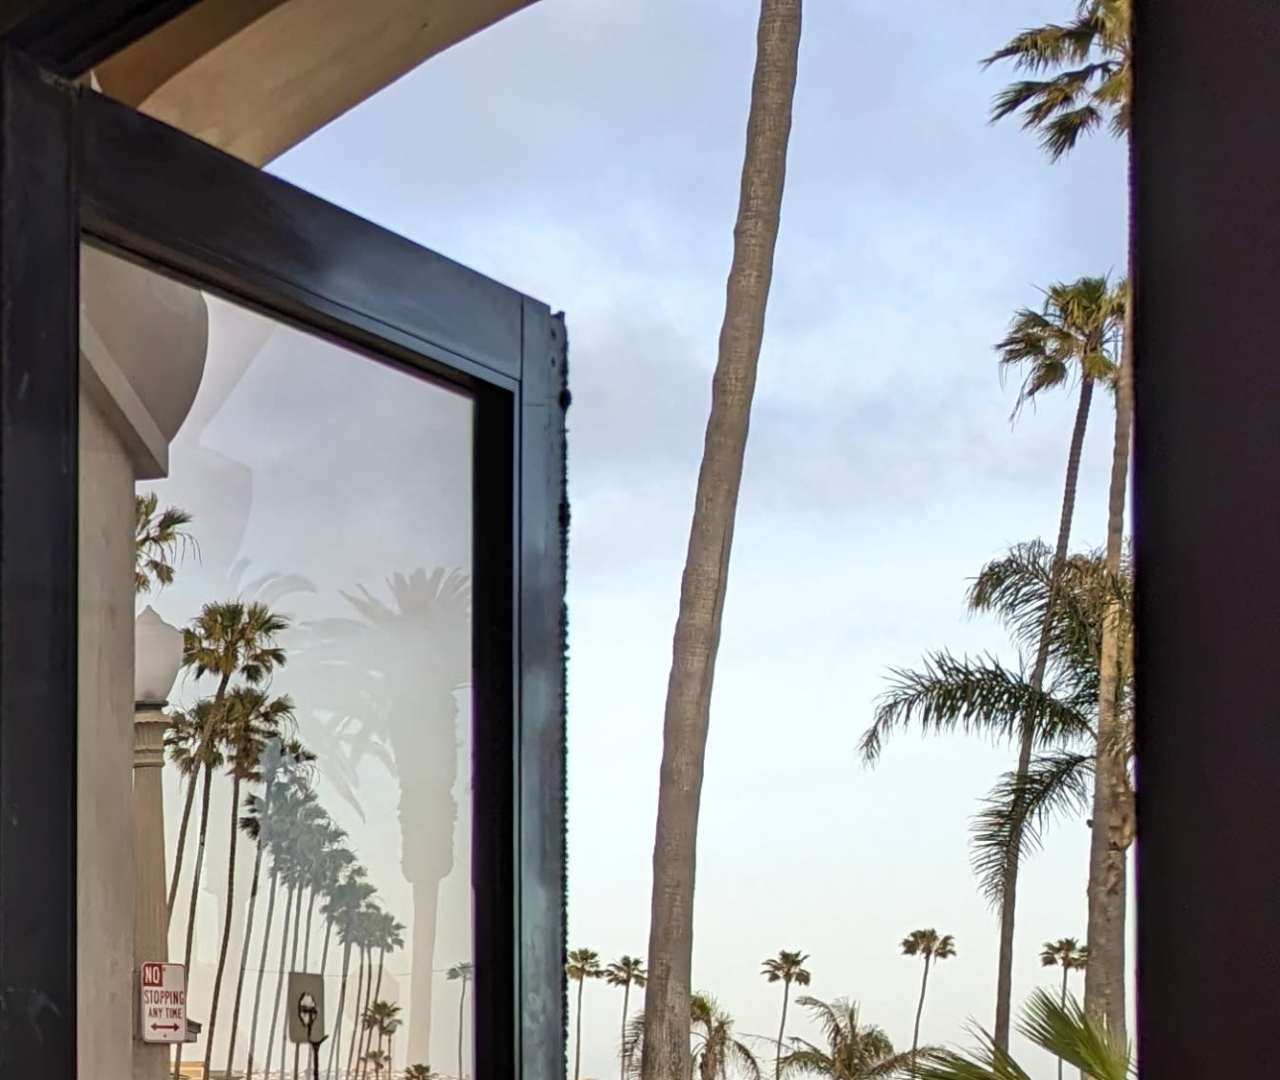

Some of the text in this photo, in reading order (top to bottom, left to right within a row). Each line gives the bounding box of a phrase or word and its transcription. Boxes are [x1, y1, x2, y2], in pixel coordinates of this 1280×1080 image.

[145, 966, 160, 984] NO
[144, 990, 184, 1005] STOPPING
[149, 1008, 182, 1019] ANY TIME
